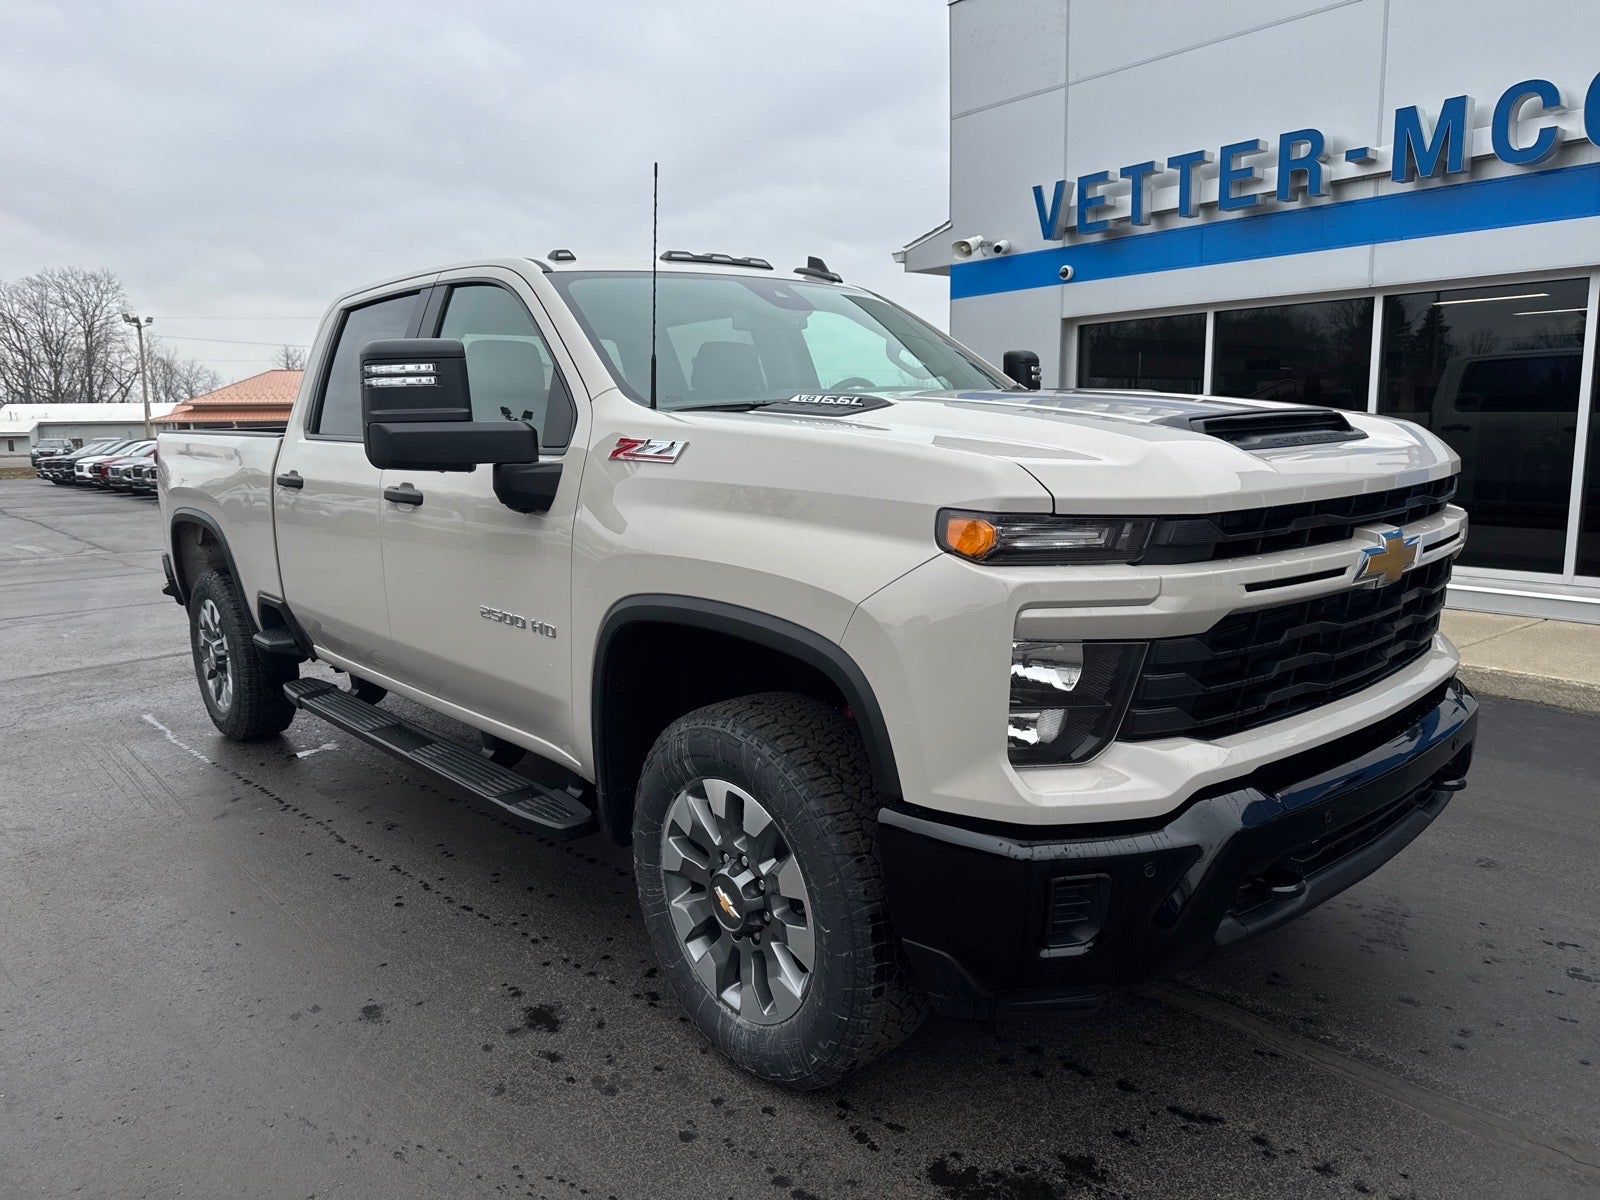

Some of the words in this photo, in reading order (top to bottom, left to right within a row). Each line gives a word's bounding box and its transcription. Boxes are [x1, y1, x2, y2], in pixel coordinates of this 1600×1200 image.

[1032, 72, 1600, 241] VETTER-MC
[608, 437, 689, 464] Z71
[480, 604, 526, 629] 2500
[531, 619, 557, 638] HD
